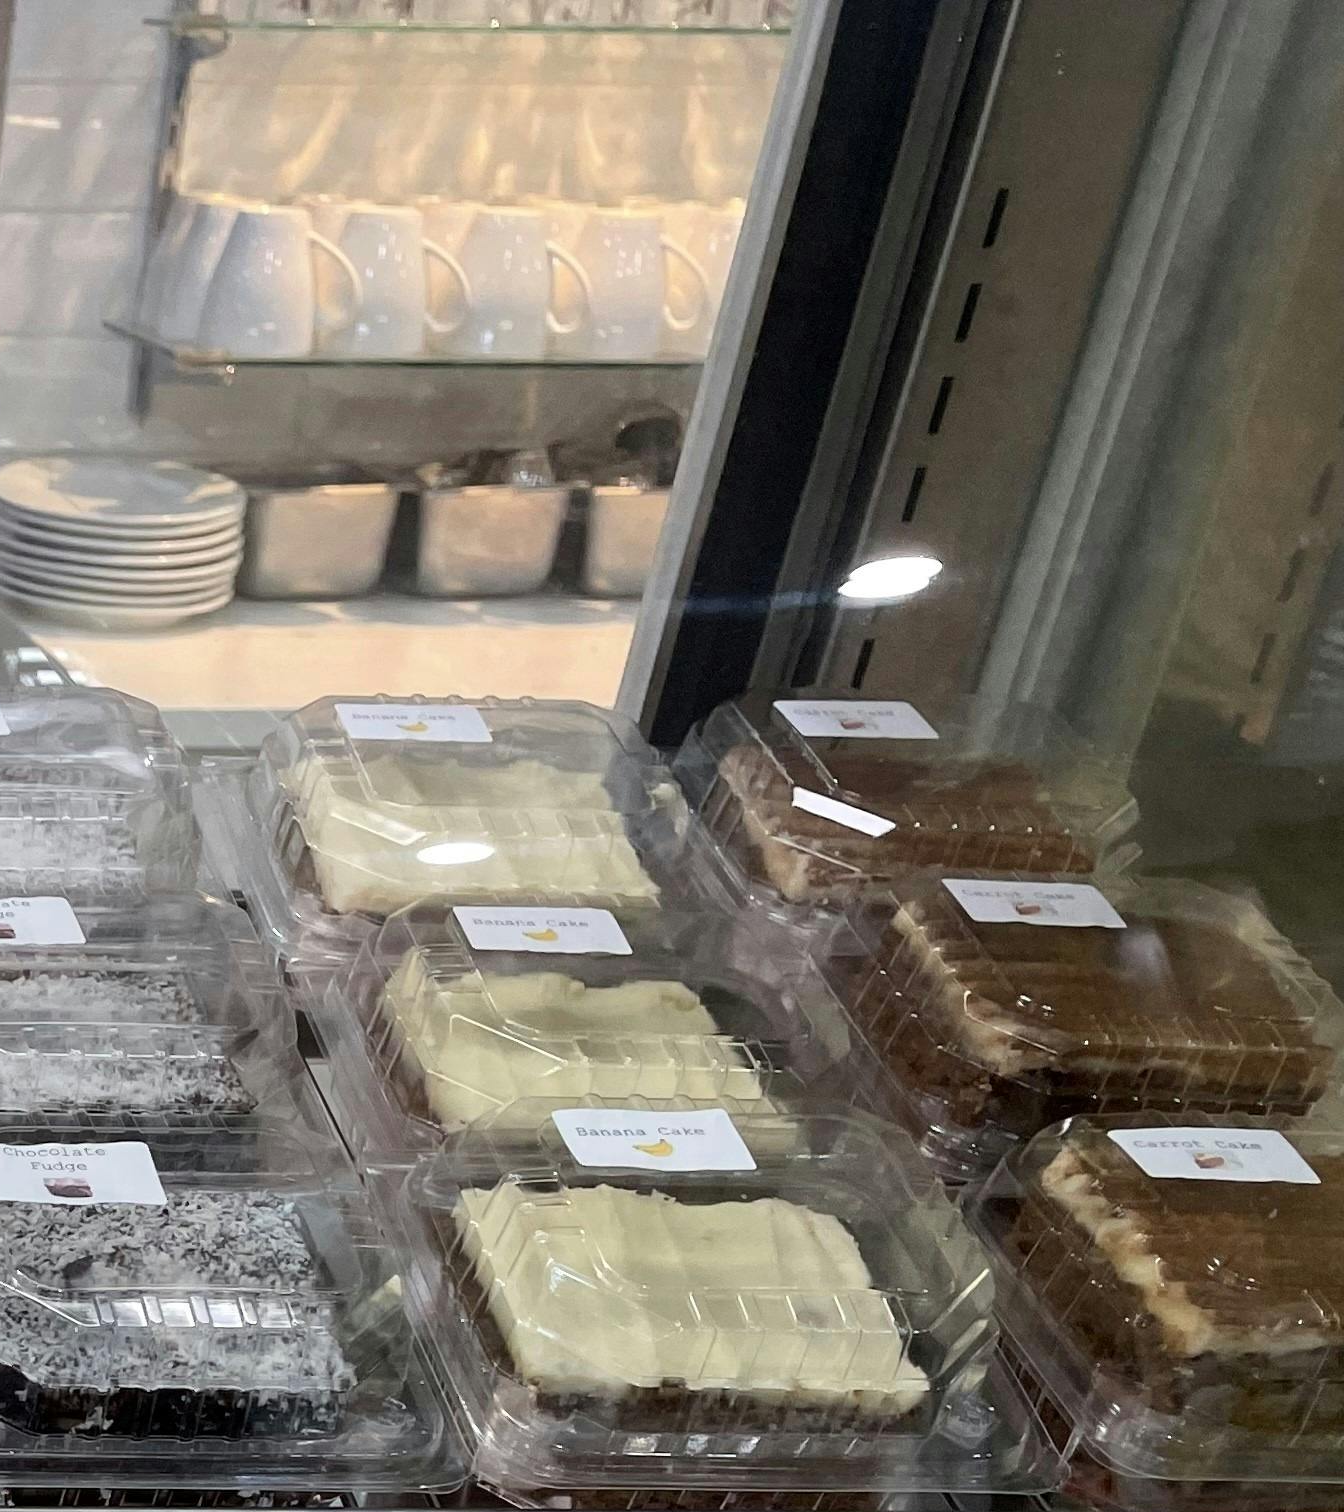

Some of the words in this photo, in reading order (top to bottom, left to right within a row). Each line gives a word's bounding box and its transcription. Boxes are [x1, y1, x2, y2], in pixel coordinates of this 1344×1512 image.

[575, 1127, 647, 1137] Banana
[657, 1126, 706, 1136] Cake
[3, 1145, 106, 1157] Chocolate
[30, 1161, 88, 1172] Fudge
